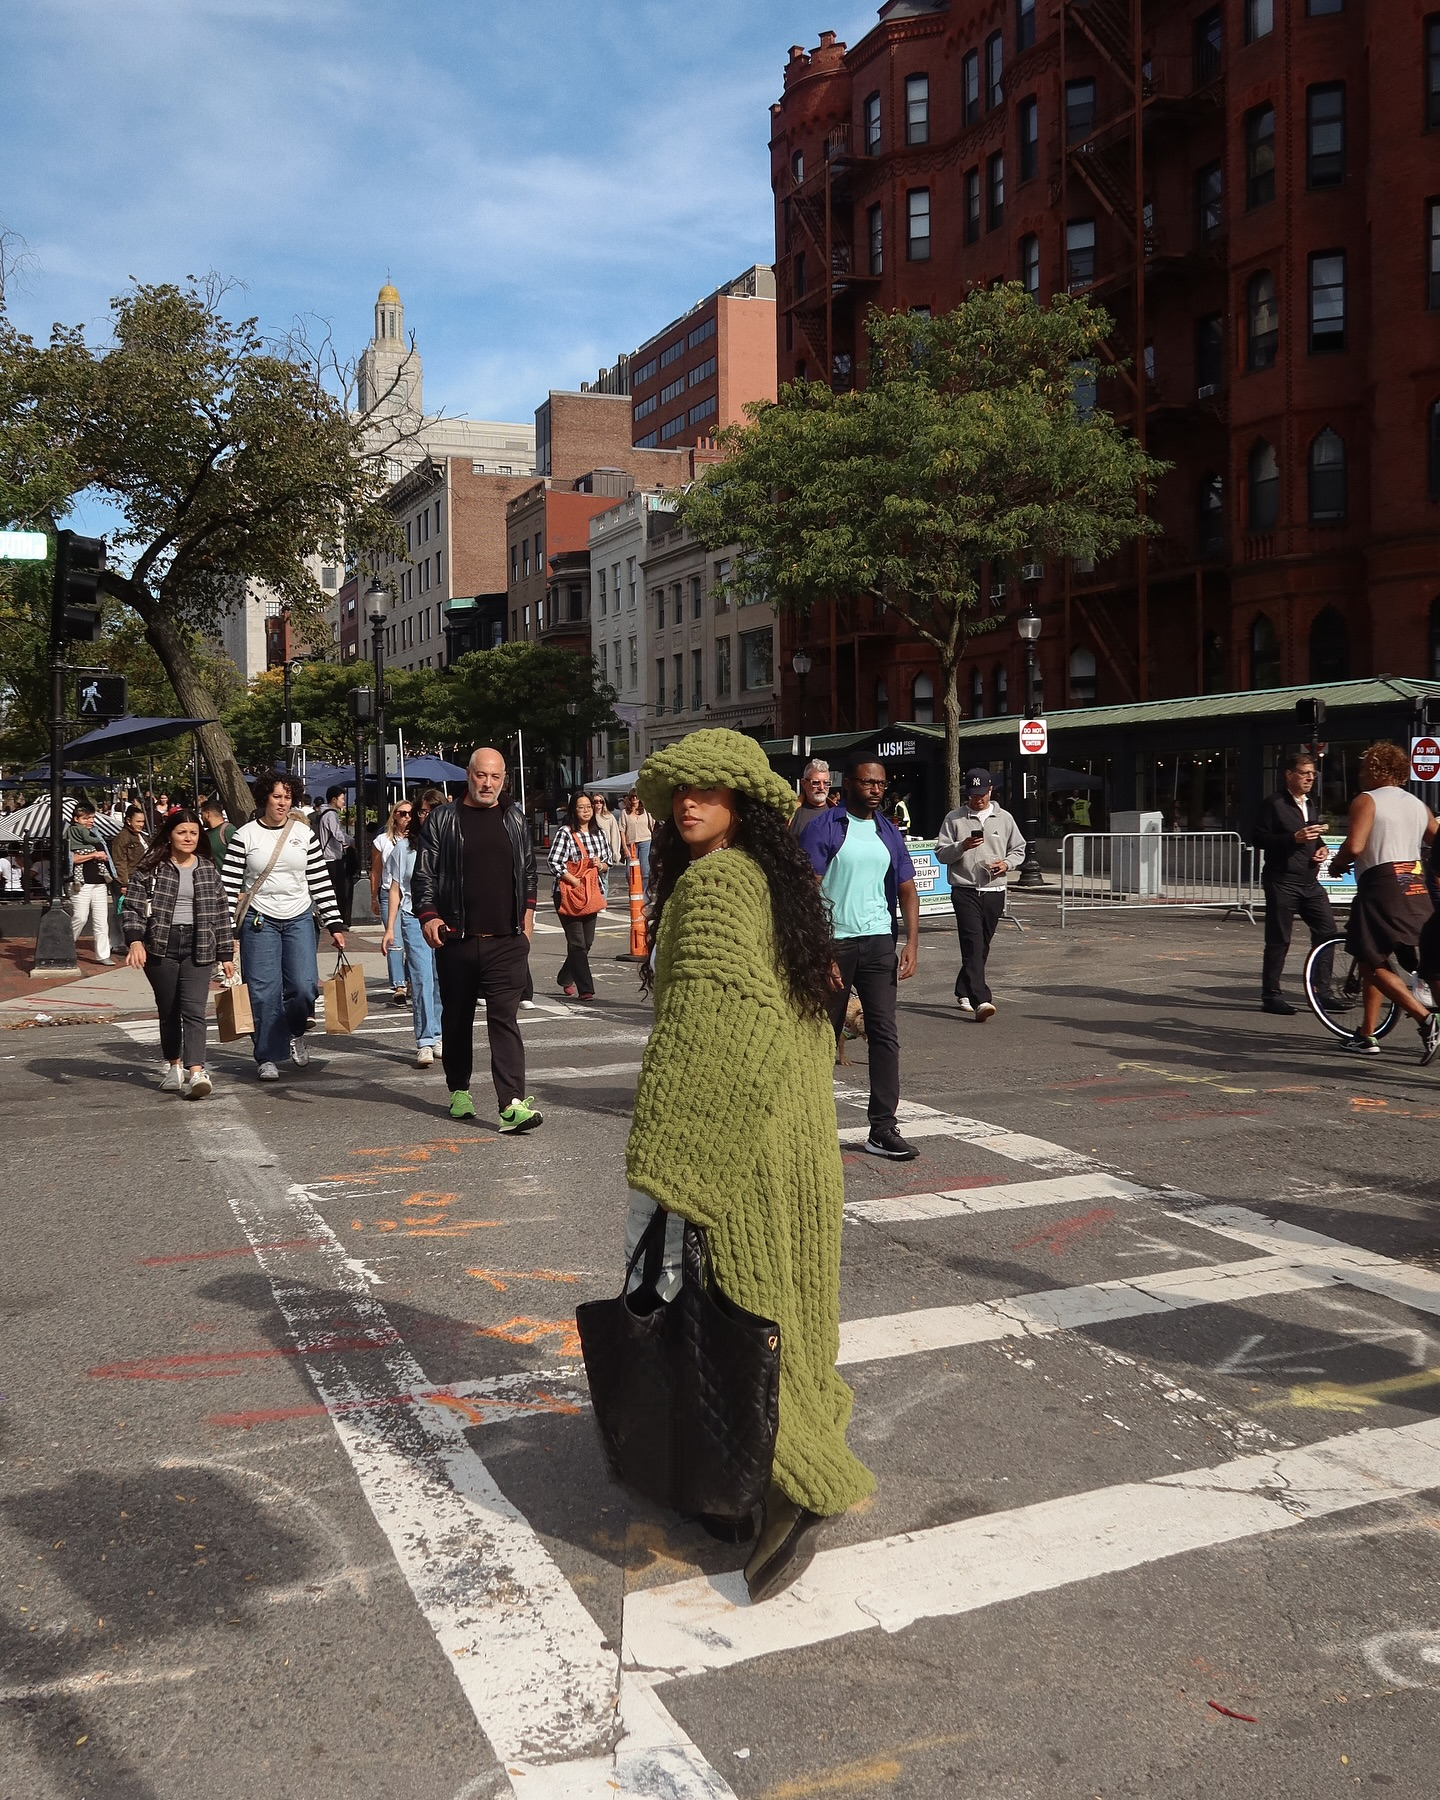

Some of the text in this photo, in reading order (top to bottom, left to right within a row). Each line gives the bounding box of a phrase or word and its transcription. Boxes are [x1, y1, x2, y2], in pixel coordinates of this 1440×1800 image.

[878, 741, 903, 757] LUSH
[1416, 746, 1437, 754] DO NOT
[1417, 764, 1435, 772] ENTER
[913, 857, 929, 865] PEN
[917, 868, 938, 877] BURY
[914, 880, 932, 889] REET
